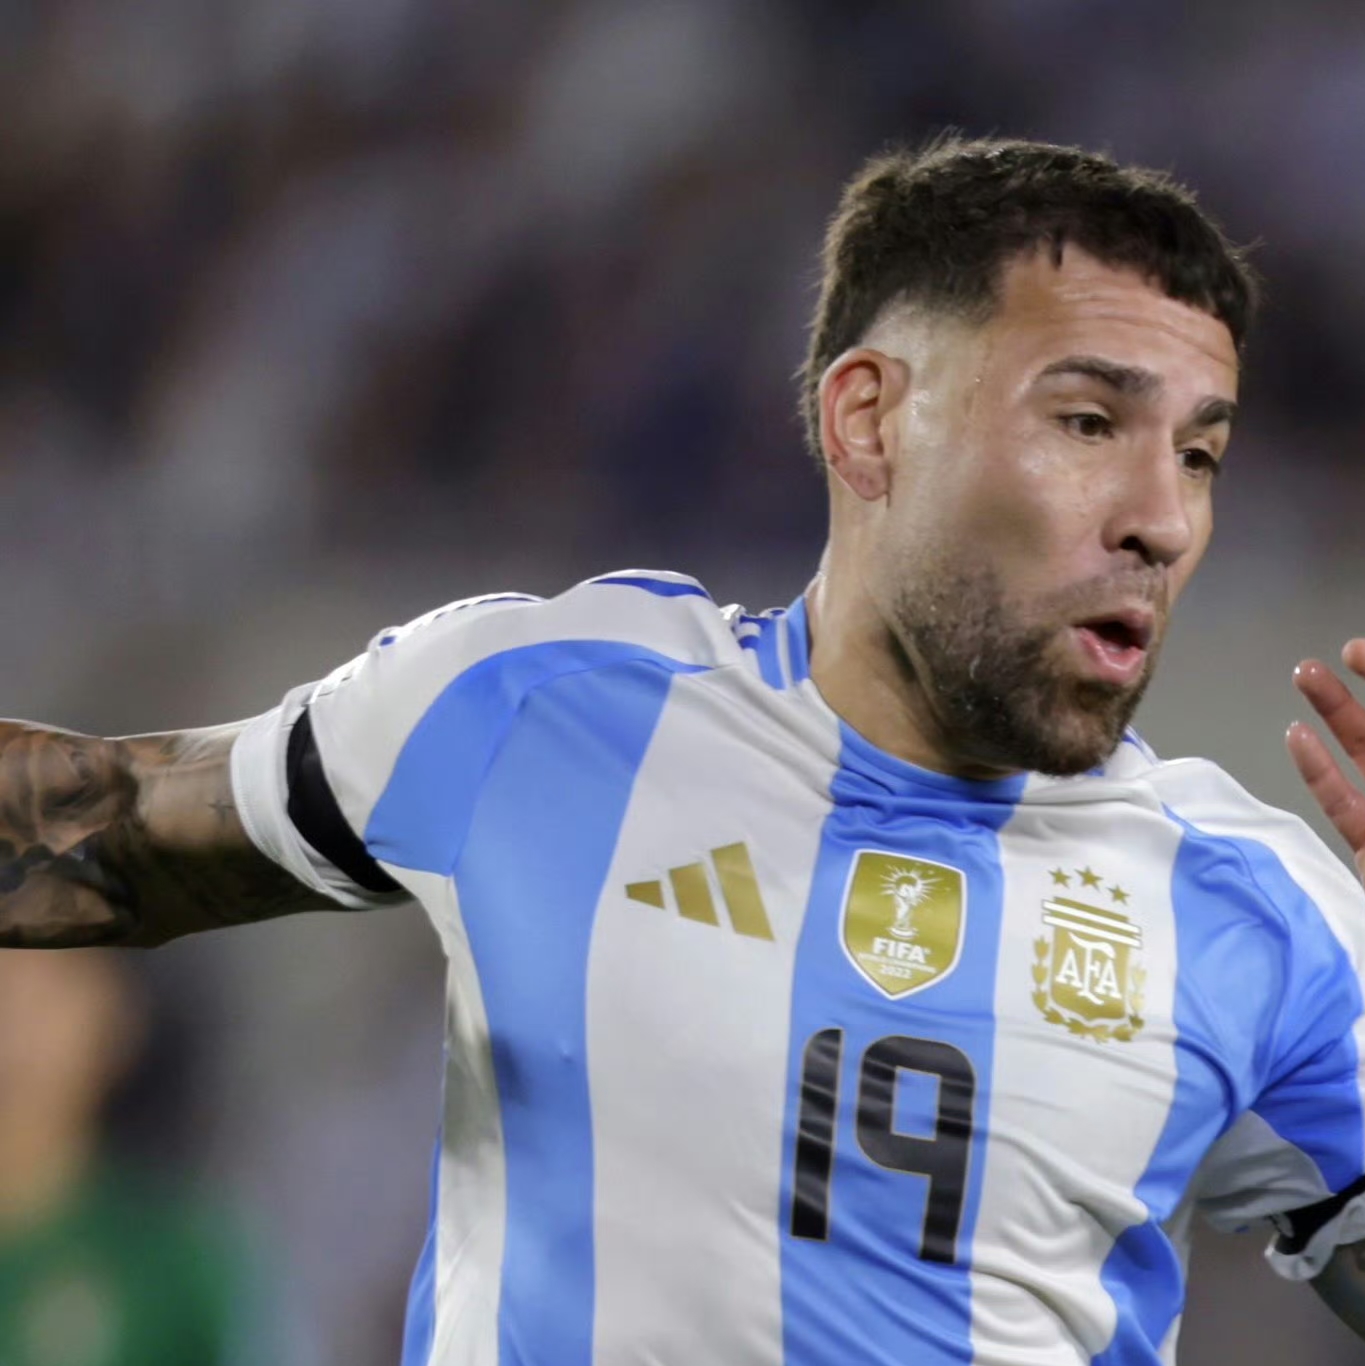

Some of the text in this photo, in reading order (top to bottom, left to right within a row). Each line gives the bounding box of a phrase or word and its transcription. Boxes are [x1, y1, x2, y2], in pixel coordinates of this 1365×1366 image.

[872, 936, 926, 964] FIFA
[1055, 931, 1123, 1006] AFA
[789, 1027, 976, 1264] 19
